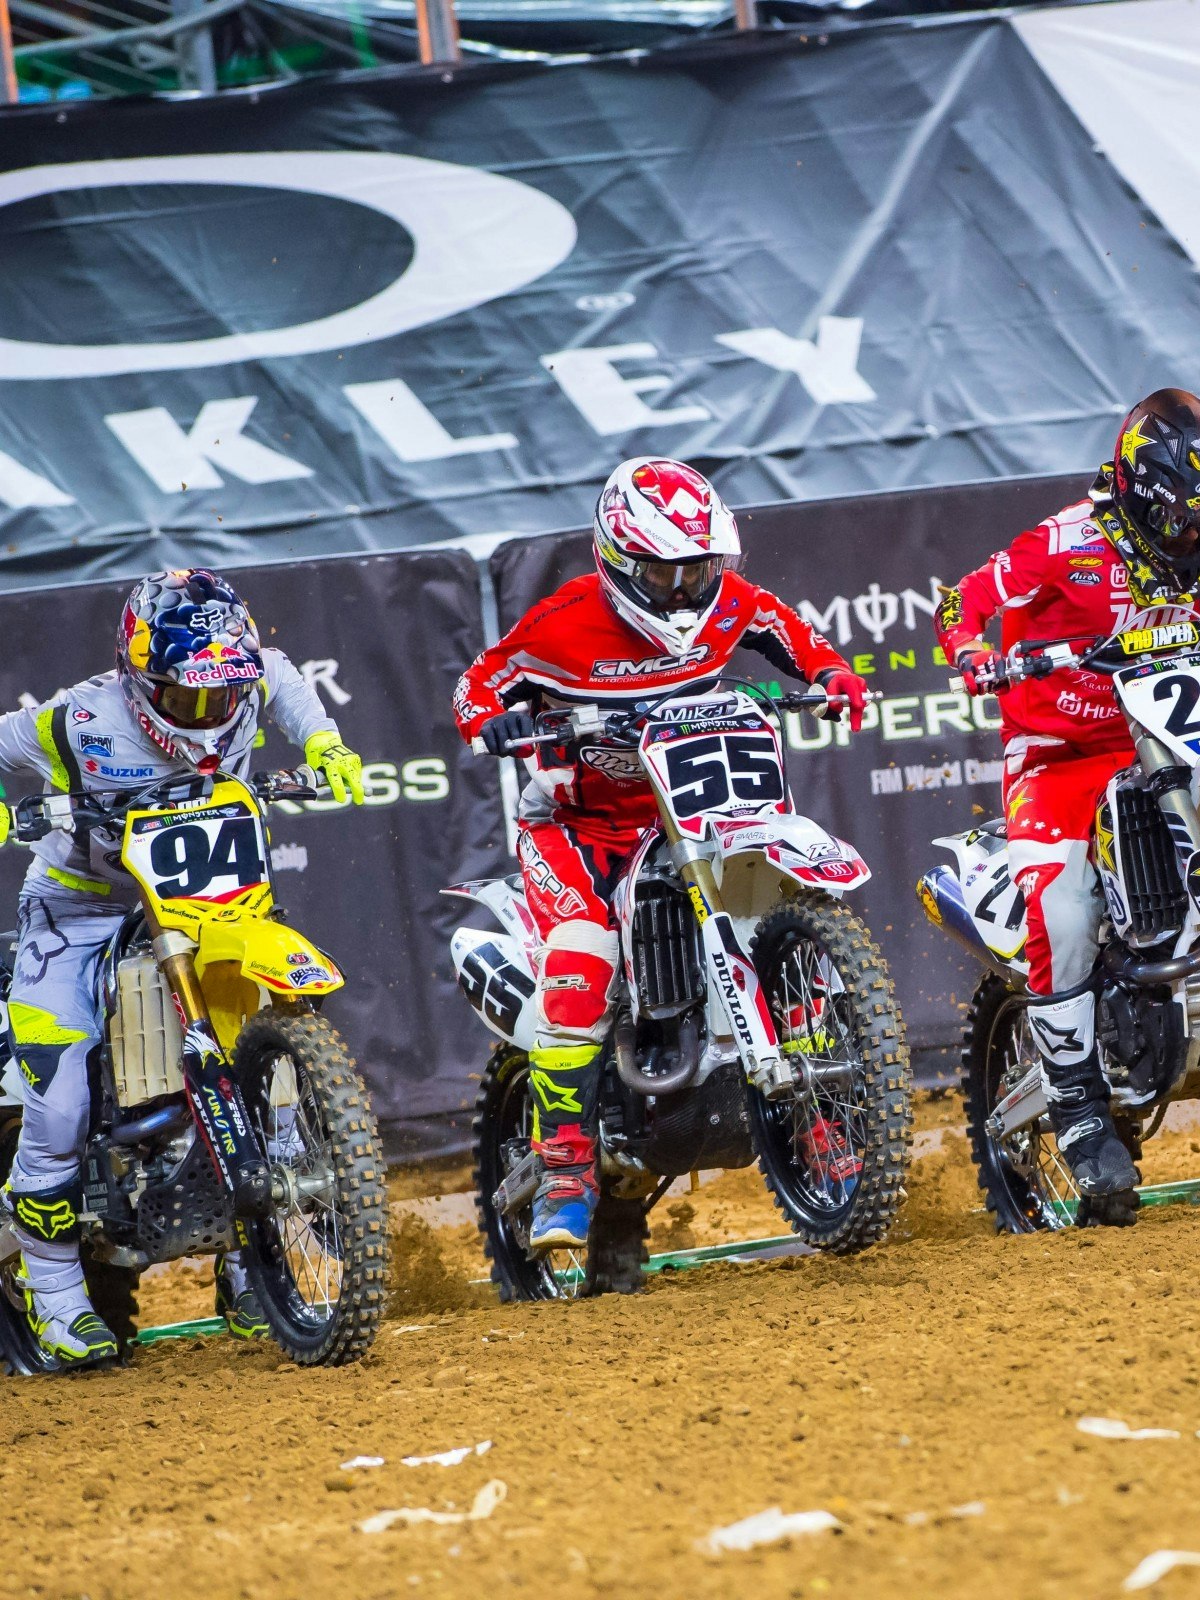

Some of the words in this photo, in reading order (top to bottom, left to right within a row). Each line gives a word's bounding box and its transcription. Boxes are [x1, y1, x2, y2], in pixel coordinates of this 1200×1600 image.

[185, 665, 222, 684] Red
[222, 663, 259, 679] Bull
[100, 765, 154, 778] SUZUKI
[664, 736, 784, 818] 55
[173, 809, 220, 822] MONSTER
[150, 817, 265, 900] 94
[711, 951, 754, 1045] DUNLOP
[190, 1091, 235, 1192] DUNLOP
